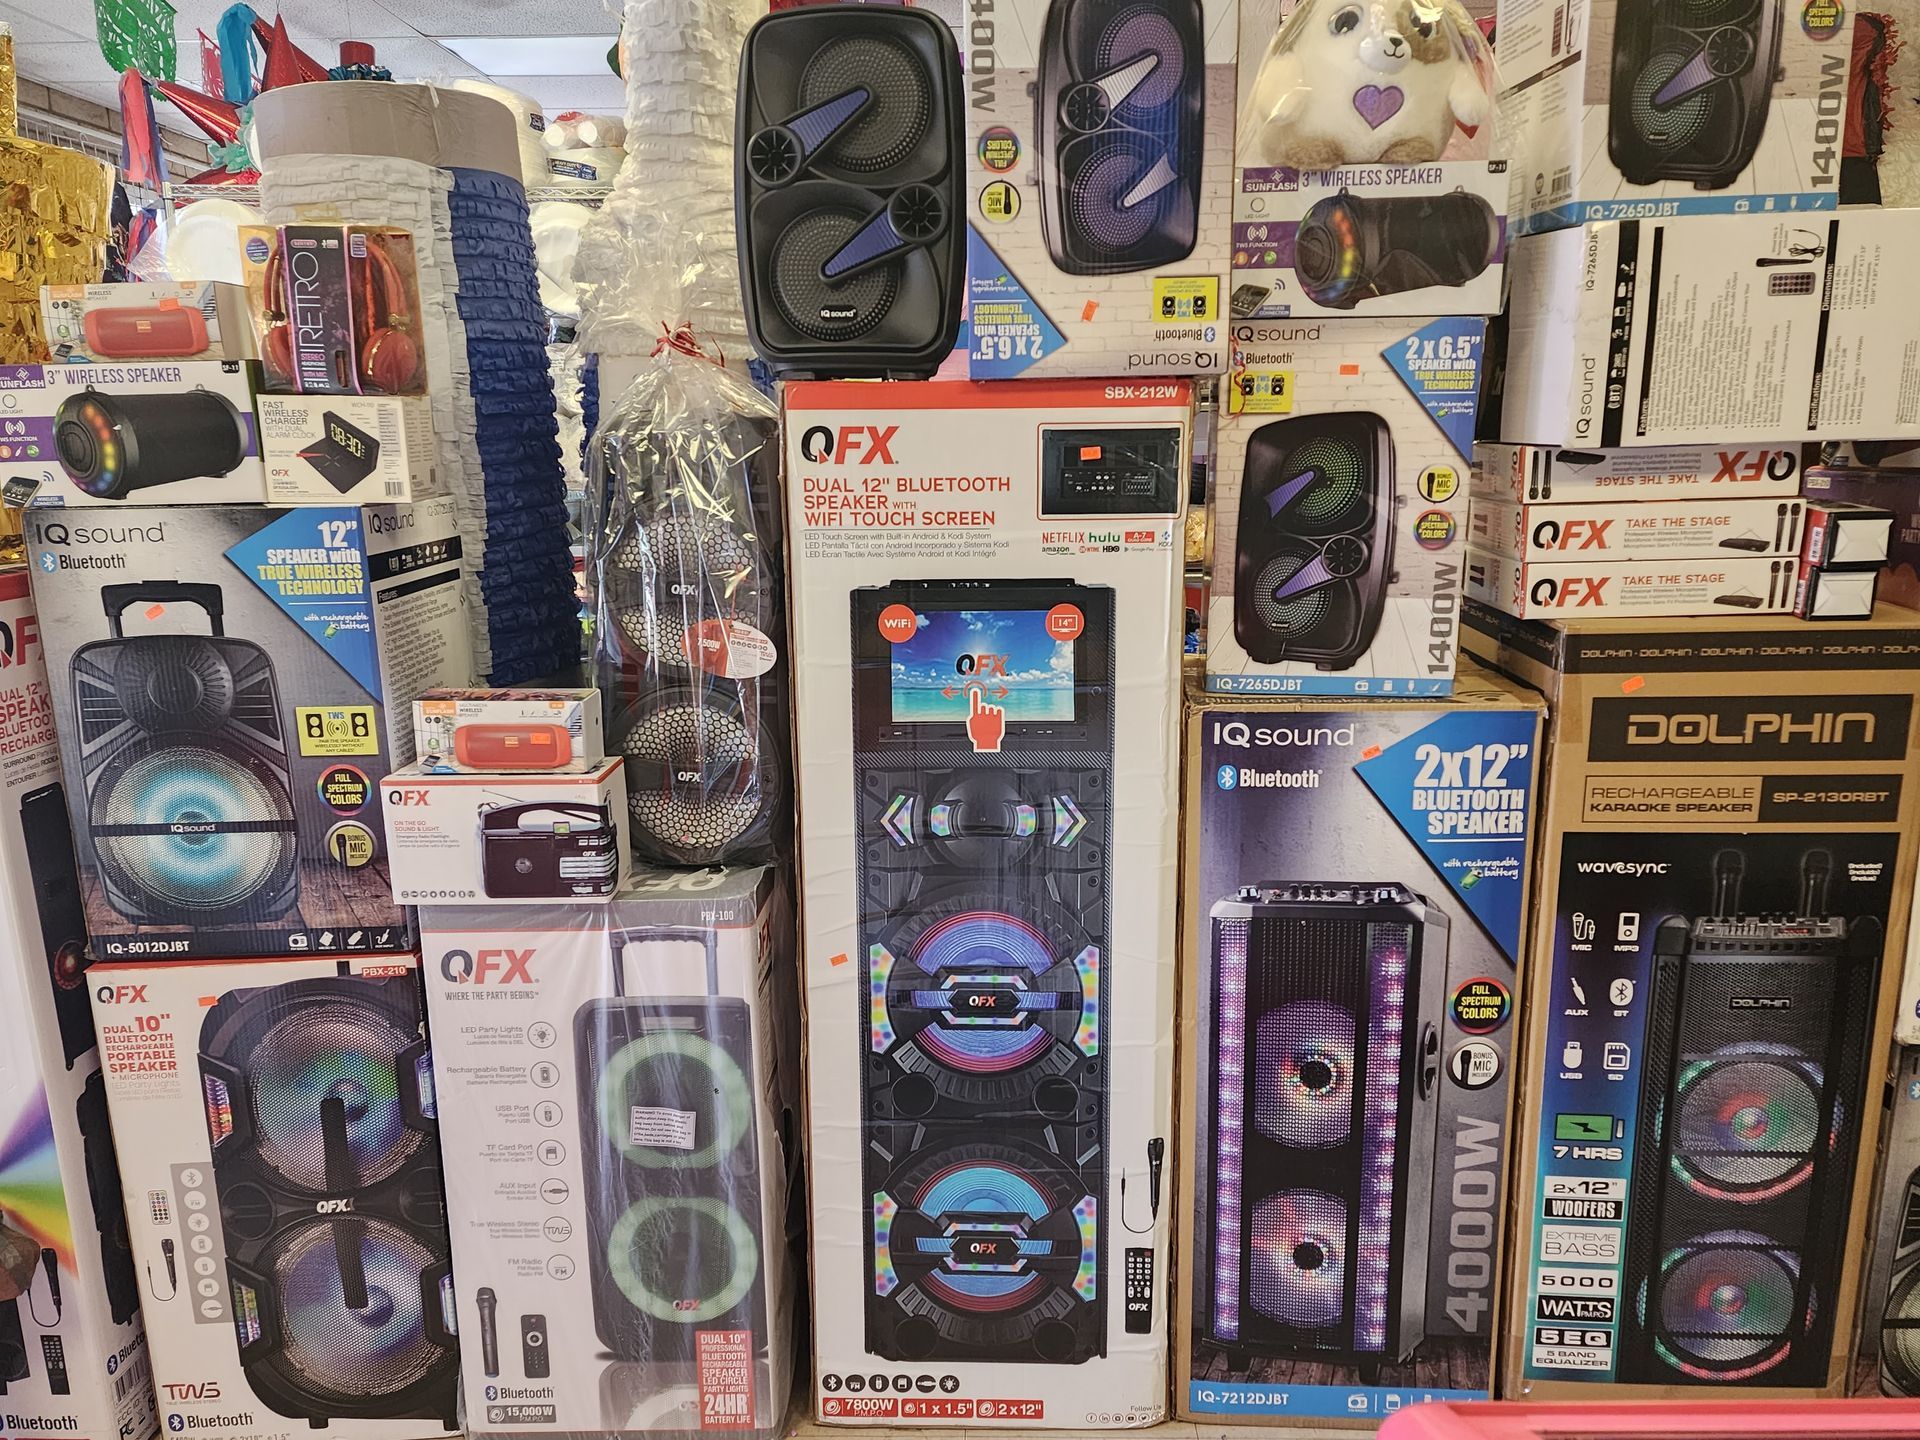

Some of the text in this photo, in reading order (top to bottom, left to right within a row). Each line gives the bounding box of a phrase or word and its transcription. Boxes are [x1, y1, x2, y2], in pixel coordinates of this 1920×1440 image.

[970, 0, 996, 112] 400W
[1811, 54, 1846, 188] 1400W
[1320, 170, 1382, 187] WIRELESS
[1385, 168, 1443, 185] SPEAKER
[1246, 181, 1298, 192] SUNFLASH
[1585, 202, 1680, 220] IQ-7265DJBT
[1821, 263, 1834, 311] Dimensions:
[292, 252, 325, 346] RETRO
[1155, 329, 1202, 341] Bluetooth
[1230, 325, 1321, 342] IQ sound
[1128, 351, 1218, 370] IQ sound
[1245, 352, 1293, 364] Bluetooth
[1408, 358, 1476, 371] SPEAKER with
[64, 369, 127, 384] WIRELESS
[128, 367, 182, 384] SPEAKER
[1414, 371, 1475, 380] TRUE WIRELESS
[1424, 380, 1474, 390] TECHNOLOGY
[1104, 385, 1178, 400] SBX-212W
[1575, 357, 1596, 439] IQ sound
[263, 401, 284, 409] FAST
[264, 409, 309, 417] WIRELESS
[265, 417, 308, 425] CHARGER
[801, 425, 899, 465] QFX
[1711, 450, 1797, 482] QFX
[803, 477, 1010, 493] DUAL 12" BLUETOOTH
[1595, 474, 1699, 486] TAKE THE STAGE
[804, 495, 917, 510] SPEAKER WITH
[805, 511, 995, 527] WIFI TOUCH SCREEN
[1626, 516, 1731, 528] TAKE THE STAGE
[36, 522, 164, 546] IQ sound
[804, 532, 992, 542] LED Touch Screen with Built-in Android & Kodi System
[1042, 532, 1085, 544] NETFLIX
[1088, 531, 1121, 543] hulu
[1532, 520, 1614, 551] QFX
[59, 554, 126, 570] Bluetooth
[267, 548, 361, 565] SPEAKER with
[258, 565, 362, 580] TRUE WIRELESS
[1622, 574, 1726, 586] TAKE THE STAGE
[277, 580, 364, 596] TECHNOLOGY
[670, 584, 695, 596] QFX
[1531, 576, 1611, 608] QFX
[884, 618, 911, 629] WiFi
[1428, 561, 1459, 675] 1400W
[956, 653, 1008, 677] QFX
[1215, 679, 1303, 691] IQ-7265DJBT
[1213, 722, 1355, 748] IQ sound
[1626, 712, 1876, 745] DOLPHIN
[335, 773, 352, 782] FULL
[1239, 768, 1320, 788] Bluetooth
[327, 783, 363, 793] SPECTRUM
[1592, 787, 1755, 799] RECHARGEABLE
[330, 793, 363, 806] COLORS
[388, 789, 430, 806] QFX
[1412, 789, 1525, 811] BLUETOOTH
[1772, 791, 1890, 803] SP-2130RBT
[1590, 802, 1754, 812] KARAOKE SPEAKER
[1427, 811, 1524, 835] SPEAKER
[1443, 858, 1520, 871] with rechargeable
[1577, 862, 1668, 877] wavesync
[1484, 867, 1519, 880] battery
[701, 910, 734, 922] PBX-100
[106, 941, 190, 954] IQ-5012DJBT
[1571, 944, 1592, 952] MIC
[362, 965, 406, 977] PBX-210
[440, 948, 537, 985] QFX
[97, 984, 148, 1004] QFX
[445, 991, 535, 1001] WHERE THE PARTY BEGINS
[1471, 985, 1490, 996] FULL
[968, 995, 997, 1008] QFX
[1461, 995, 1501, 1007] SPECTRUM
[1732, 999, 1790, 1008] DOLPHIN
[1462, 1005, 1498, 1020] COLORS
[1564, 1009, 1629, 1017] AUX BT
[103, 1013, 171, 1034] DUAL 10"
[479, 1027, 498, 1035] Party
[500, 1026, 523, 1034] Lights
[104, 1033, 173, 1044] BLUETOOTH
[106, 1043, 175, 1051] RECHARGEABLE
[107, 1050, 176, 1061] PORTABLE
[109, 1061, 177, 1073] SPEAKER
[446, 1066, 526, 1075] Rechargeable Battery
[1553, 1146, 1623, 1161] 7 HRS
[1552, 1200, 1616, 1219] WOOFERS
[1445, 1115, 1501, 1333] 4000W
[1545, 1231, 1617, 1243] EXTREME
[970, 1242, 997, 1254] QFX
[1545, 1242, 1616, 1258] BASS
[1541, 1275, 1614, 1289] 5000
[1128, 1303, 1149, 1312] QFX
[1541, 1300, 1612, 1318] WATTS
[701, 1334, 727, 1344] DUAL
[701, 1344, 746, 1352] PROFESSIONAL
[702, 1352, 747, 1361] BLUETOOTH
[1535, 1357, 1609, 1367] EQUALIZER
[702, 1360, 747, 1368] RECHARGEABLE
[702, 1368, 748, 1377] SPEAKER
[703, 1376, 748, 1385] LED CIRCLE
[500, 1386, 554, 1399] Bluetooth
[704, 1385, 749, 1393] PARTY LIGHTS
[845, 1398, 894, 1411] 7800W
[1198, 1390, 1289, 1406] IQ-7212DJBT
[506, 1406, 553, 1417] 15,000W
[6, 1414, 78, 1431] Bluetooth
[187, 1414, 253, 1430] Bluetooth
[705, 1415, 751, 1424] BATTERY LIFE
